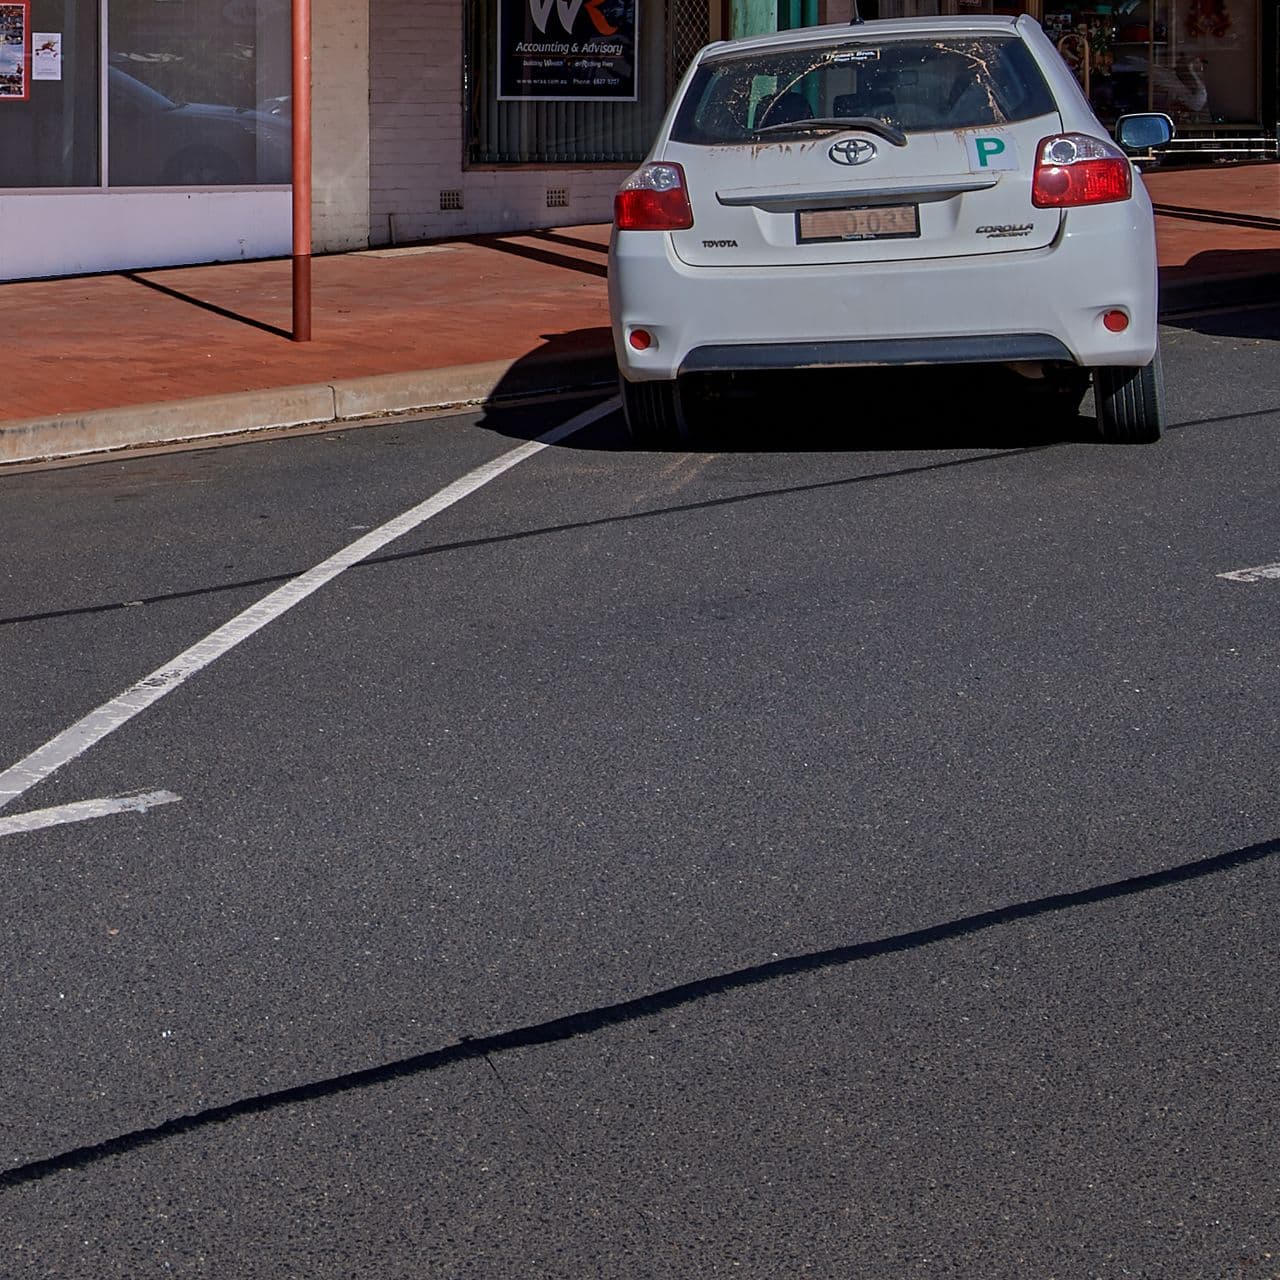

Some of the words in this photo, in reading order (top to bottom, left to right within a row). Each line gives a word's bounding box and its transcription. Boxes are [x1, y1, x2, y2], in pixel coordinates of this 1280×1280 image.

[515, 41, 569, 55] Accounting
[571, 42, 578, 53] &
[581, 42, 623, 56] Advisory
[975, 137, 1005, 168] P
[976, 223, 1033, 233] COROLLA
[702, 240, 738, 248] TOYOTA
